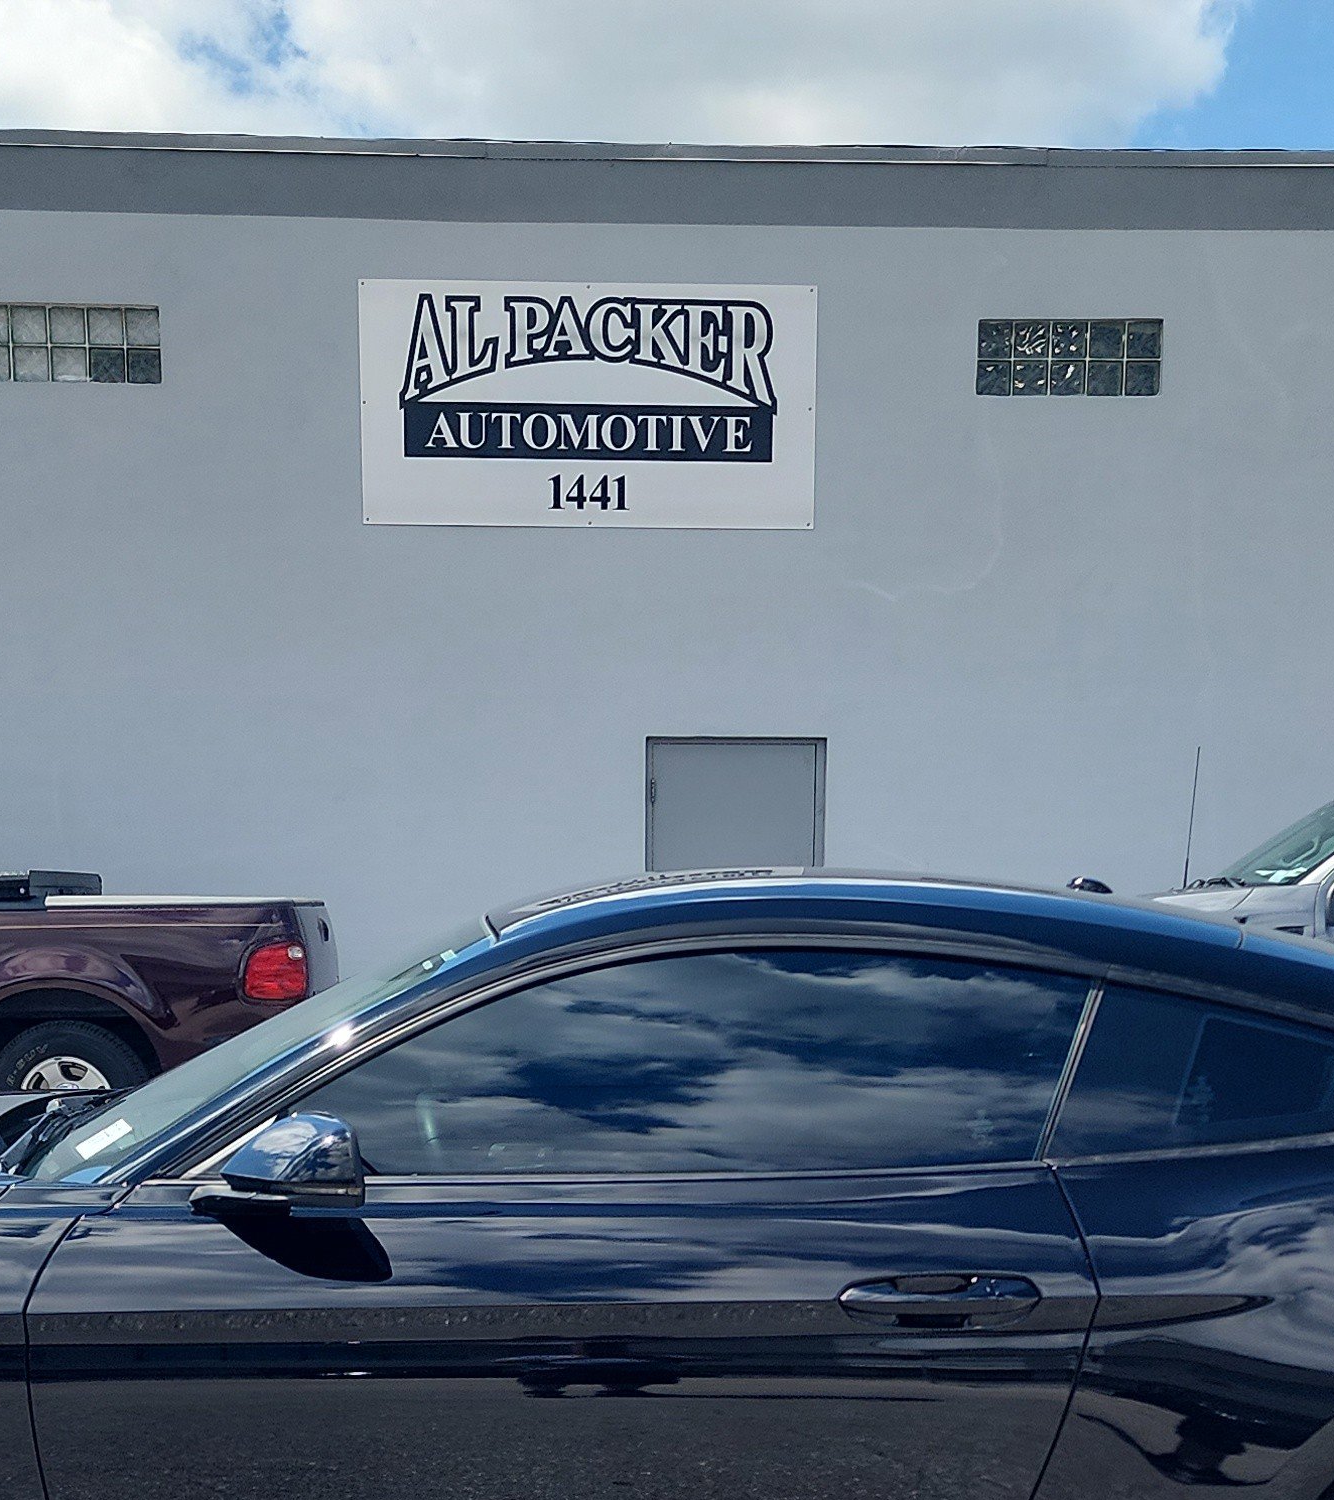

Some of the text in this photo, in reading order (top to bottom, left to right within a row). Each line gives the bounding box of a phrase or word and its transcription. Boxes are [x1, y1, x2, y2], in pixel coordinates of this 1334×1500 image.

[400, 293, 777, 413] AL PACKER
[425, 411, 753, 453] AUTOMOTIVE
[548, 473, 630, 511] 1441
